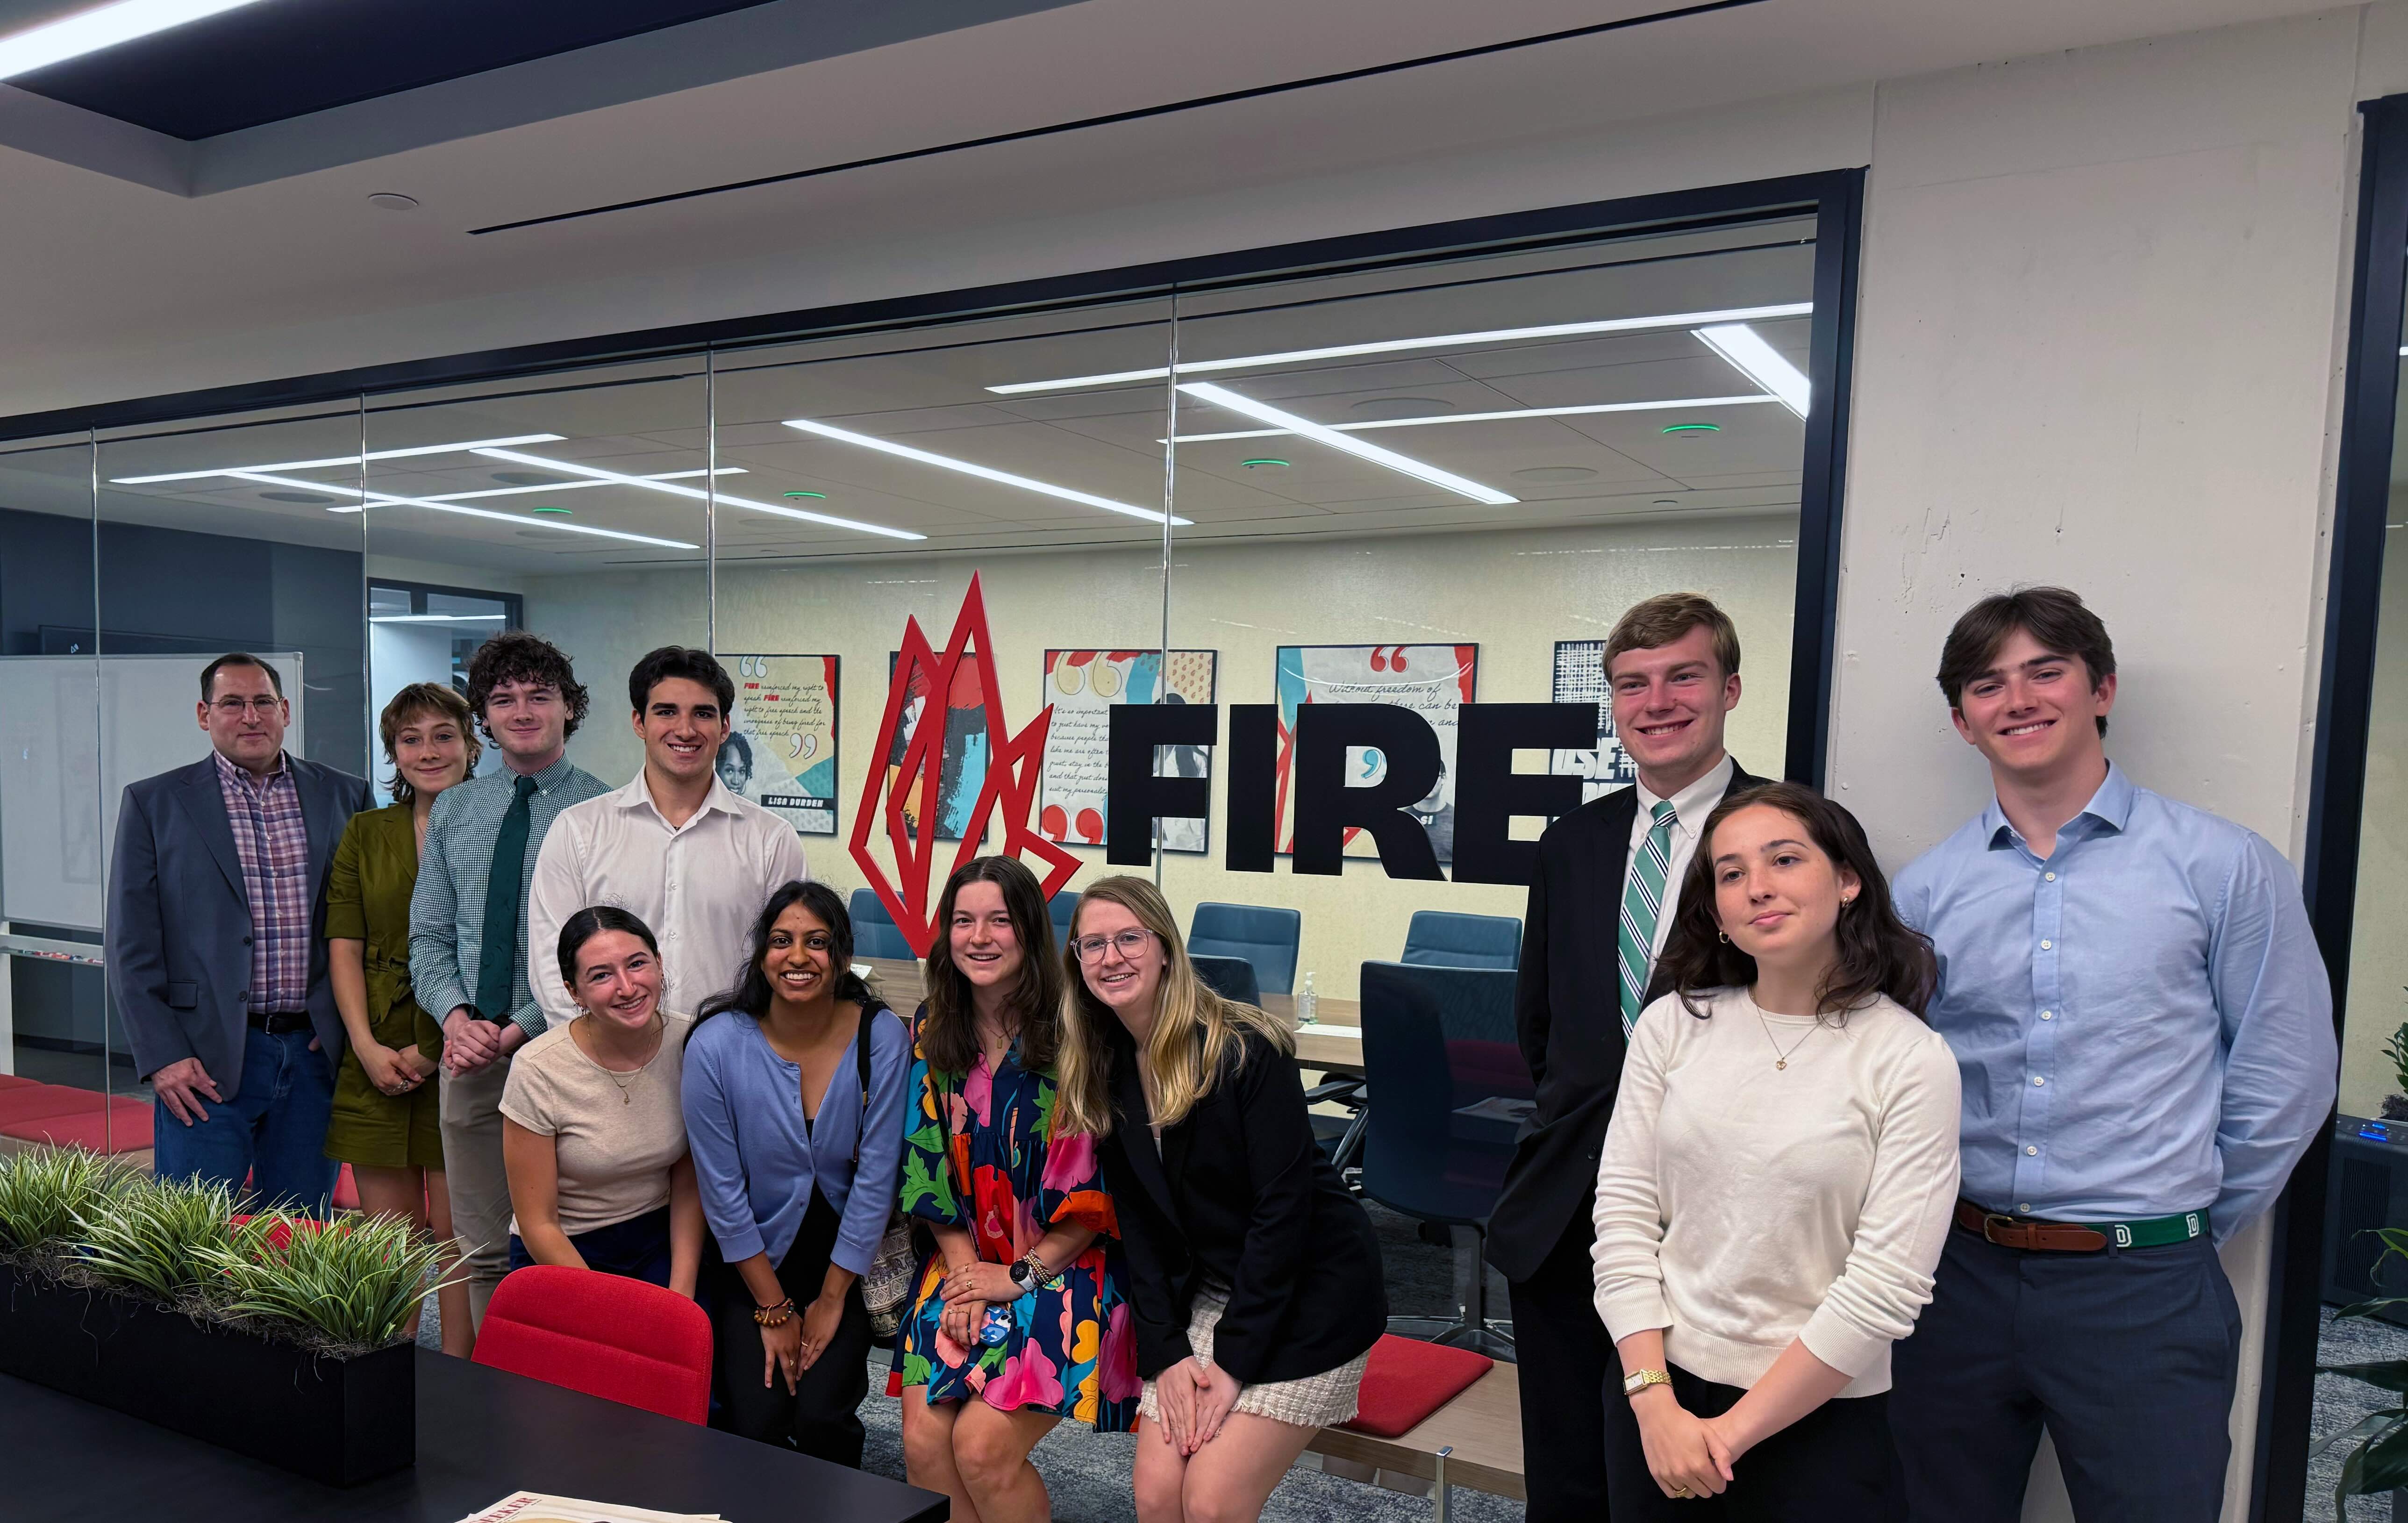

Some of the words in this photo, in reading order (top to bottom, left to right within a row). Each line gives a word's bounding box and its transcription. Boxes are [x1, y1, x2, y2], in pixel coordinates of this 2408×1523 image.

[792, 686, 801, 695] my
[1329, 681, 1373, 694] Without
[1371, 682, 1424, 702] freedom
[1426, 683, 1441, 702] of
[812, 698, 822, 708] my
[1444, 699, 1457, 710] be
[764, 707, 777, 718] free
[1076, 708, 1108, 718] important
[775, 718, 782, 729] of
[814, 719, 826, 731] for
[1056, 722, 1073, 732] just
[1090, 723, 1100, 735] my
[754, 729, 767, 740] free
[1074, 735, 1096, 745] people
[1087, 748, 1103, 760] often
[1069, 761, 1082, 773] stay
[1076, 774, 1093, 785] just
[1063, 788, 1072, 799] my
[1107, 703, 1599, 886] FIRE
[768, 797, 787, 805] LISA
[789, 798, 823, 807] DURDEN
[2186, 1213, 2200, 1237] D
[2115, 1224, 2132, 1247] D
[469, 1498, 539, 1523] EEKER
